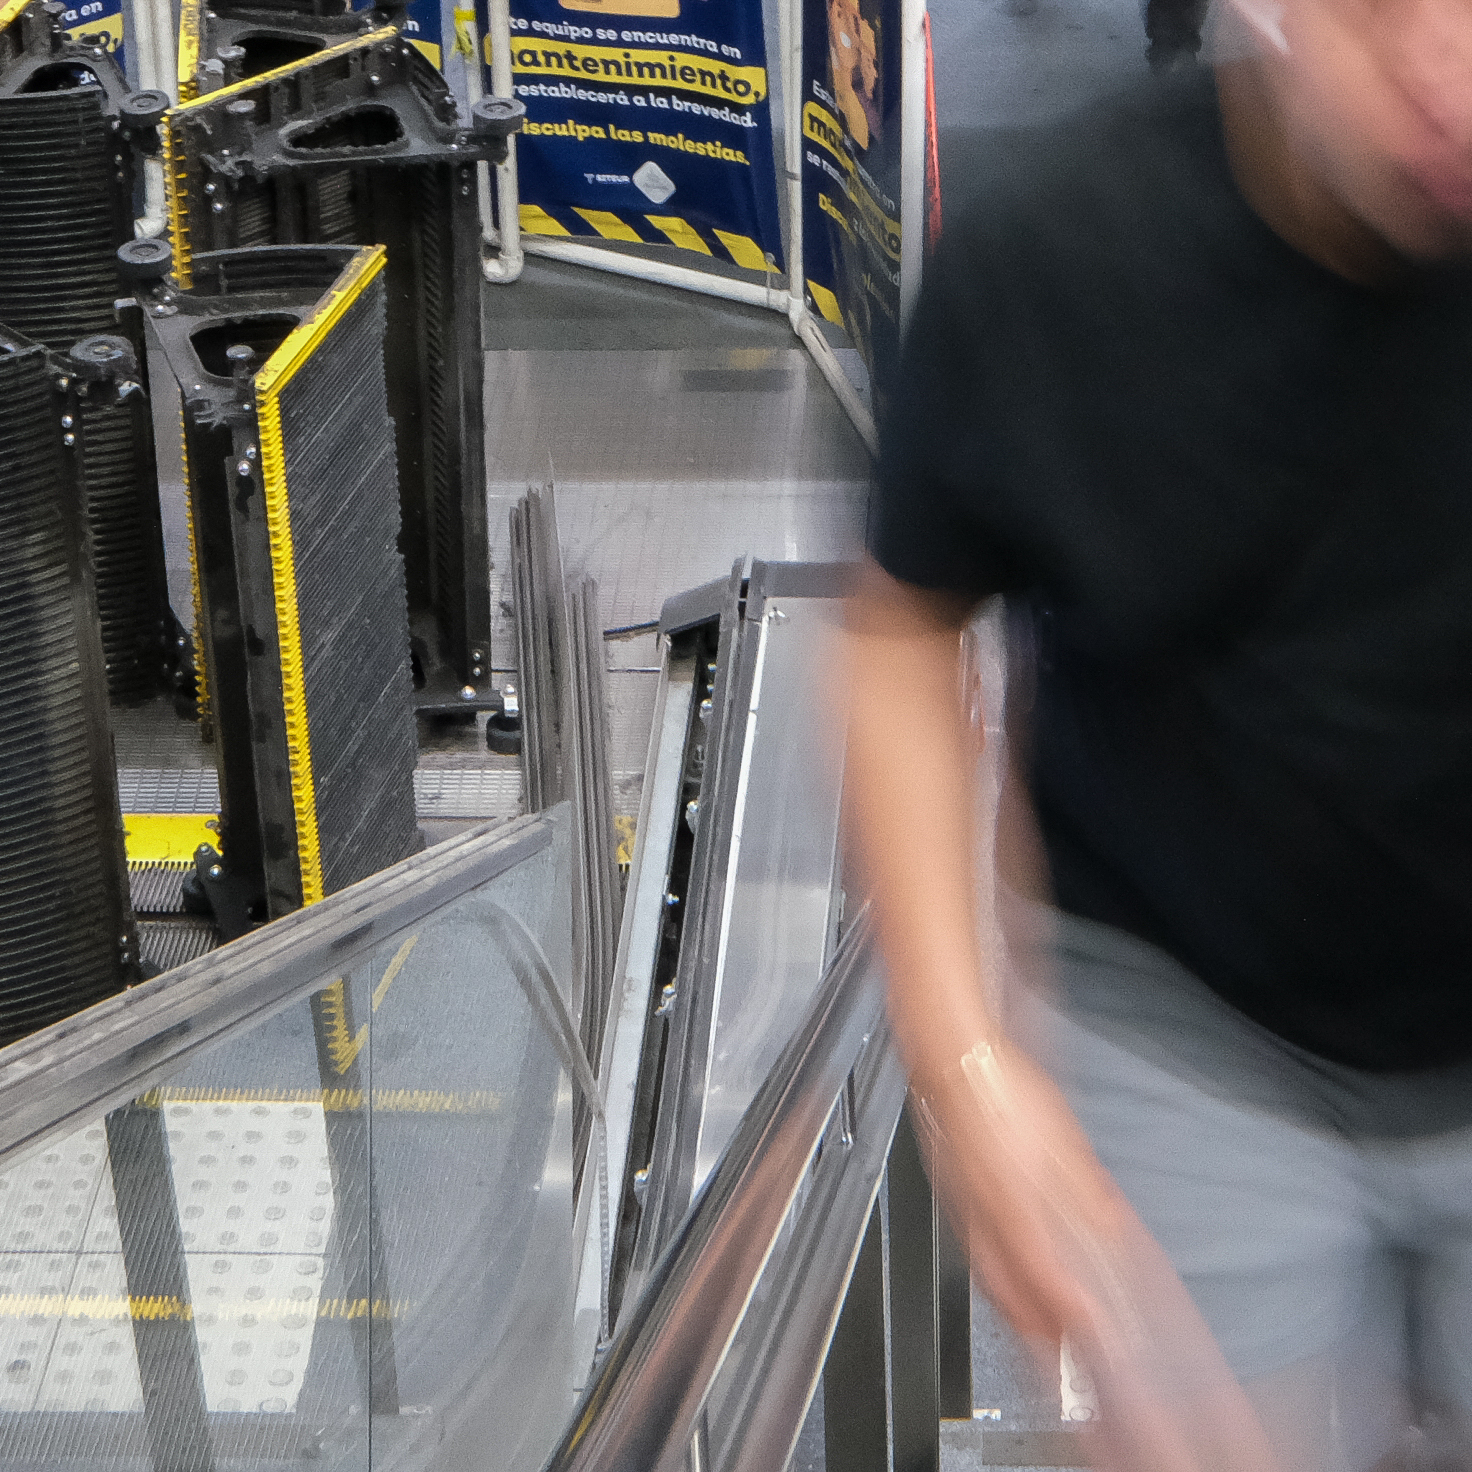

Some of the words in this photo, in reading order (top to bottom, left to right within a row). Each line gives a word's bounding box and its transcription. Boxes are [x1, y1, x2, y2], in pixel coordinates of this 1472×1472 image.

[81, 0, 103, 16] en
[531, 17, 594, 41] equipo
[596, 25, 618, 40] se
[621, 30, 718, 53] encuentra
[721, 43, 742, 59] en
[510, 46, 763, 102] antenimiento,
[633, 93, 647, 107] a
[649, 92, 670, 109] la
[672, 95, 758, 128] brevedad.
[523, 118, 607, 141] isculpa
[609, 124, 644, 142] las
[648, 130, 751, 166] molestias.
